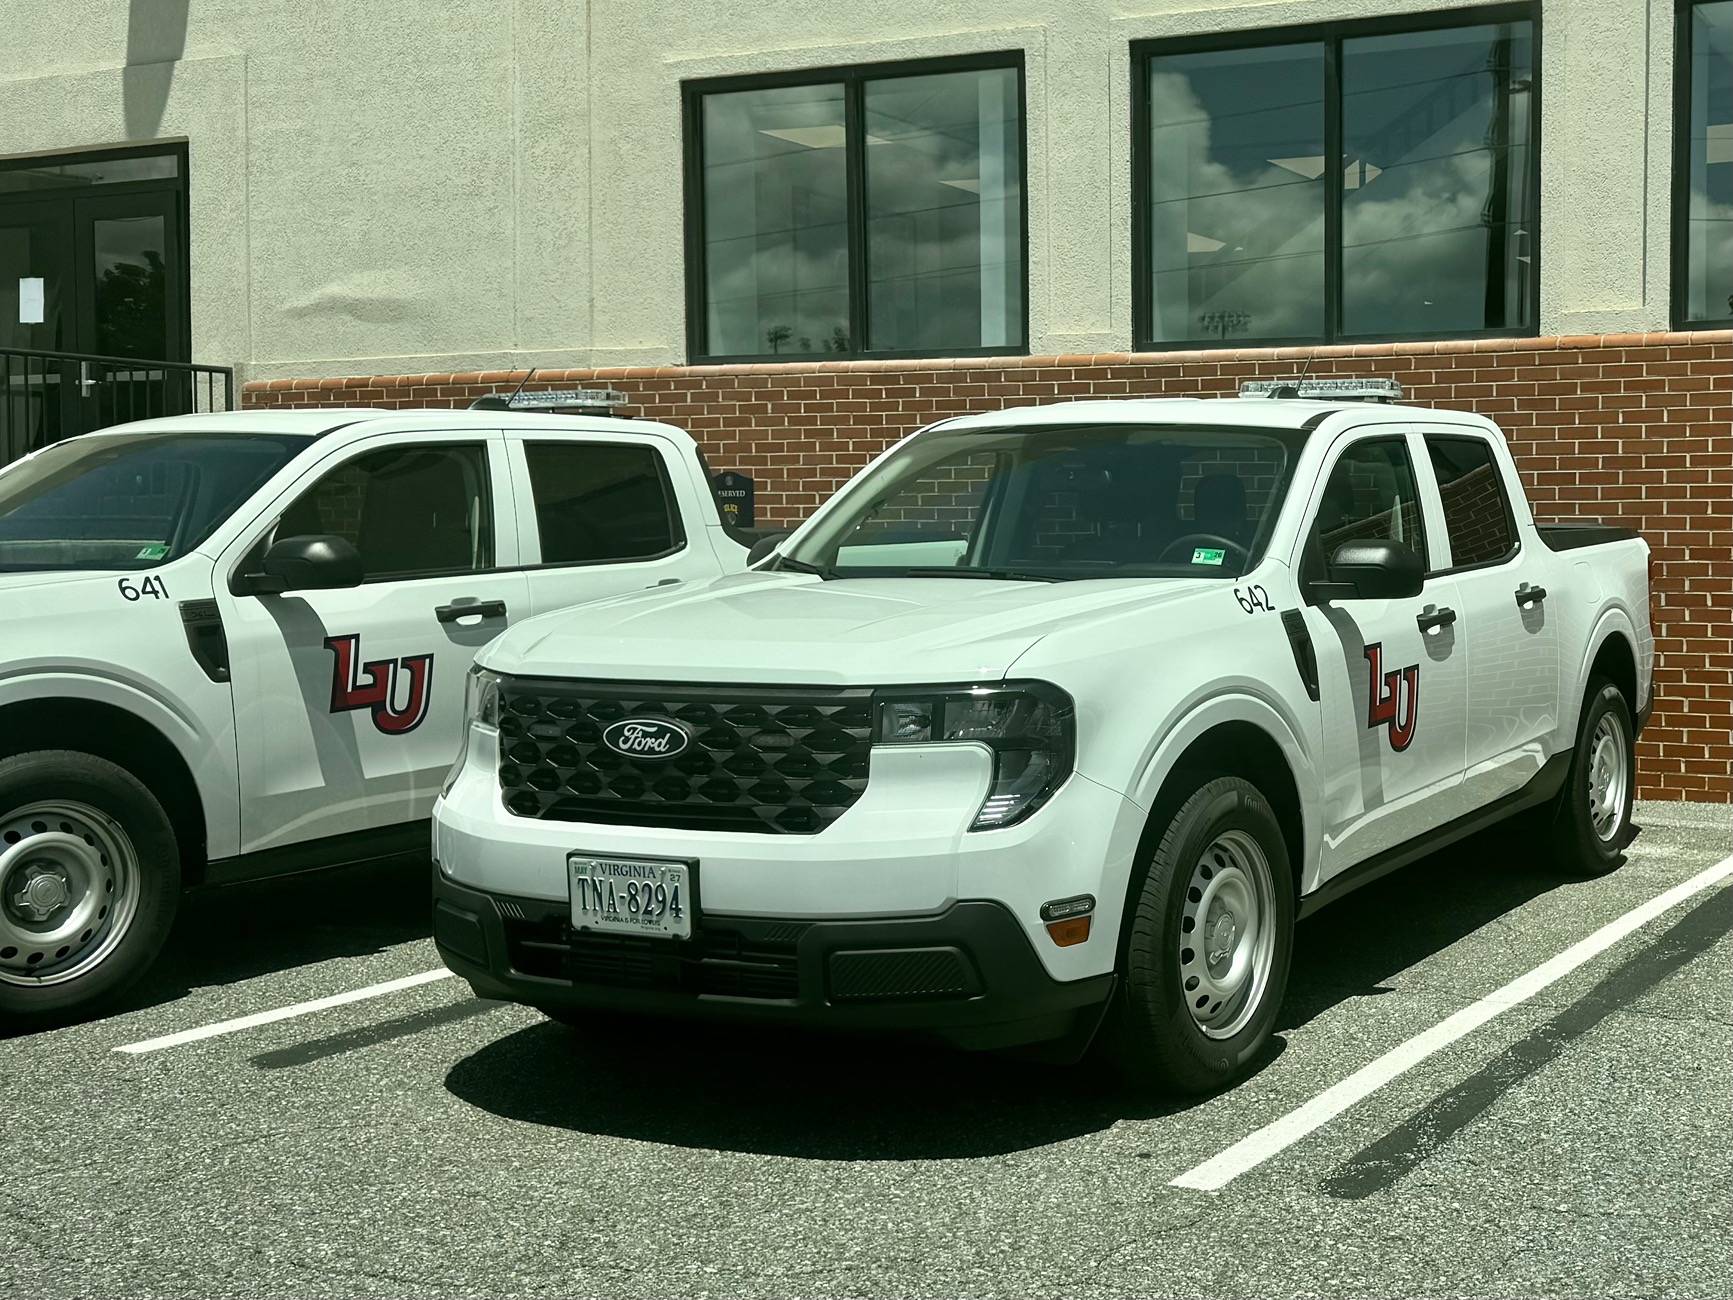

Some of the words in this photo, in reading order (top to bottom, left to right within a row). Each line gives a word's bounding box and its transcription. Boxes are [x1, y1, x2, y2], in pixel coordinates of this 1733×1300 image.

[118, 575, 170, 601] 641
[1233, 584, 1276, 614] 642
[323, 633, 434, 735] LU
[1363, 641, 1419, 752] LU
[619, 724, 671, 752] Ford
[600, 863, 657, 879] VIRGINIA
[669, 873, 681, 882] 27
[577, 876, 683, 918] TNA-8294
